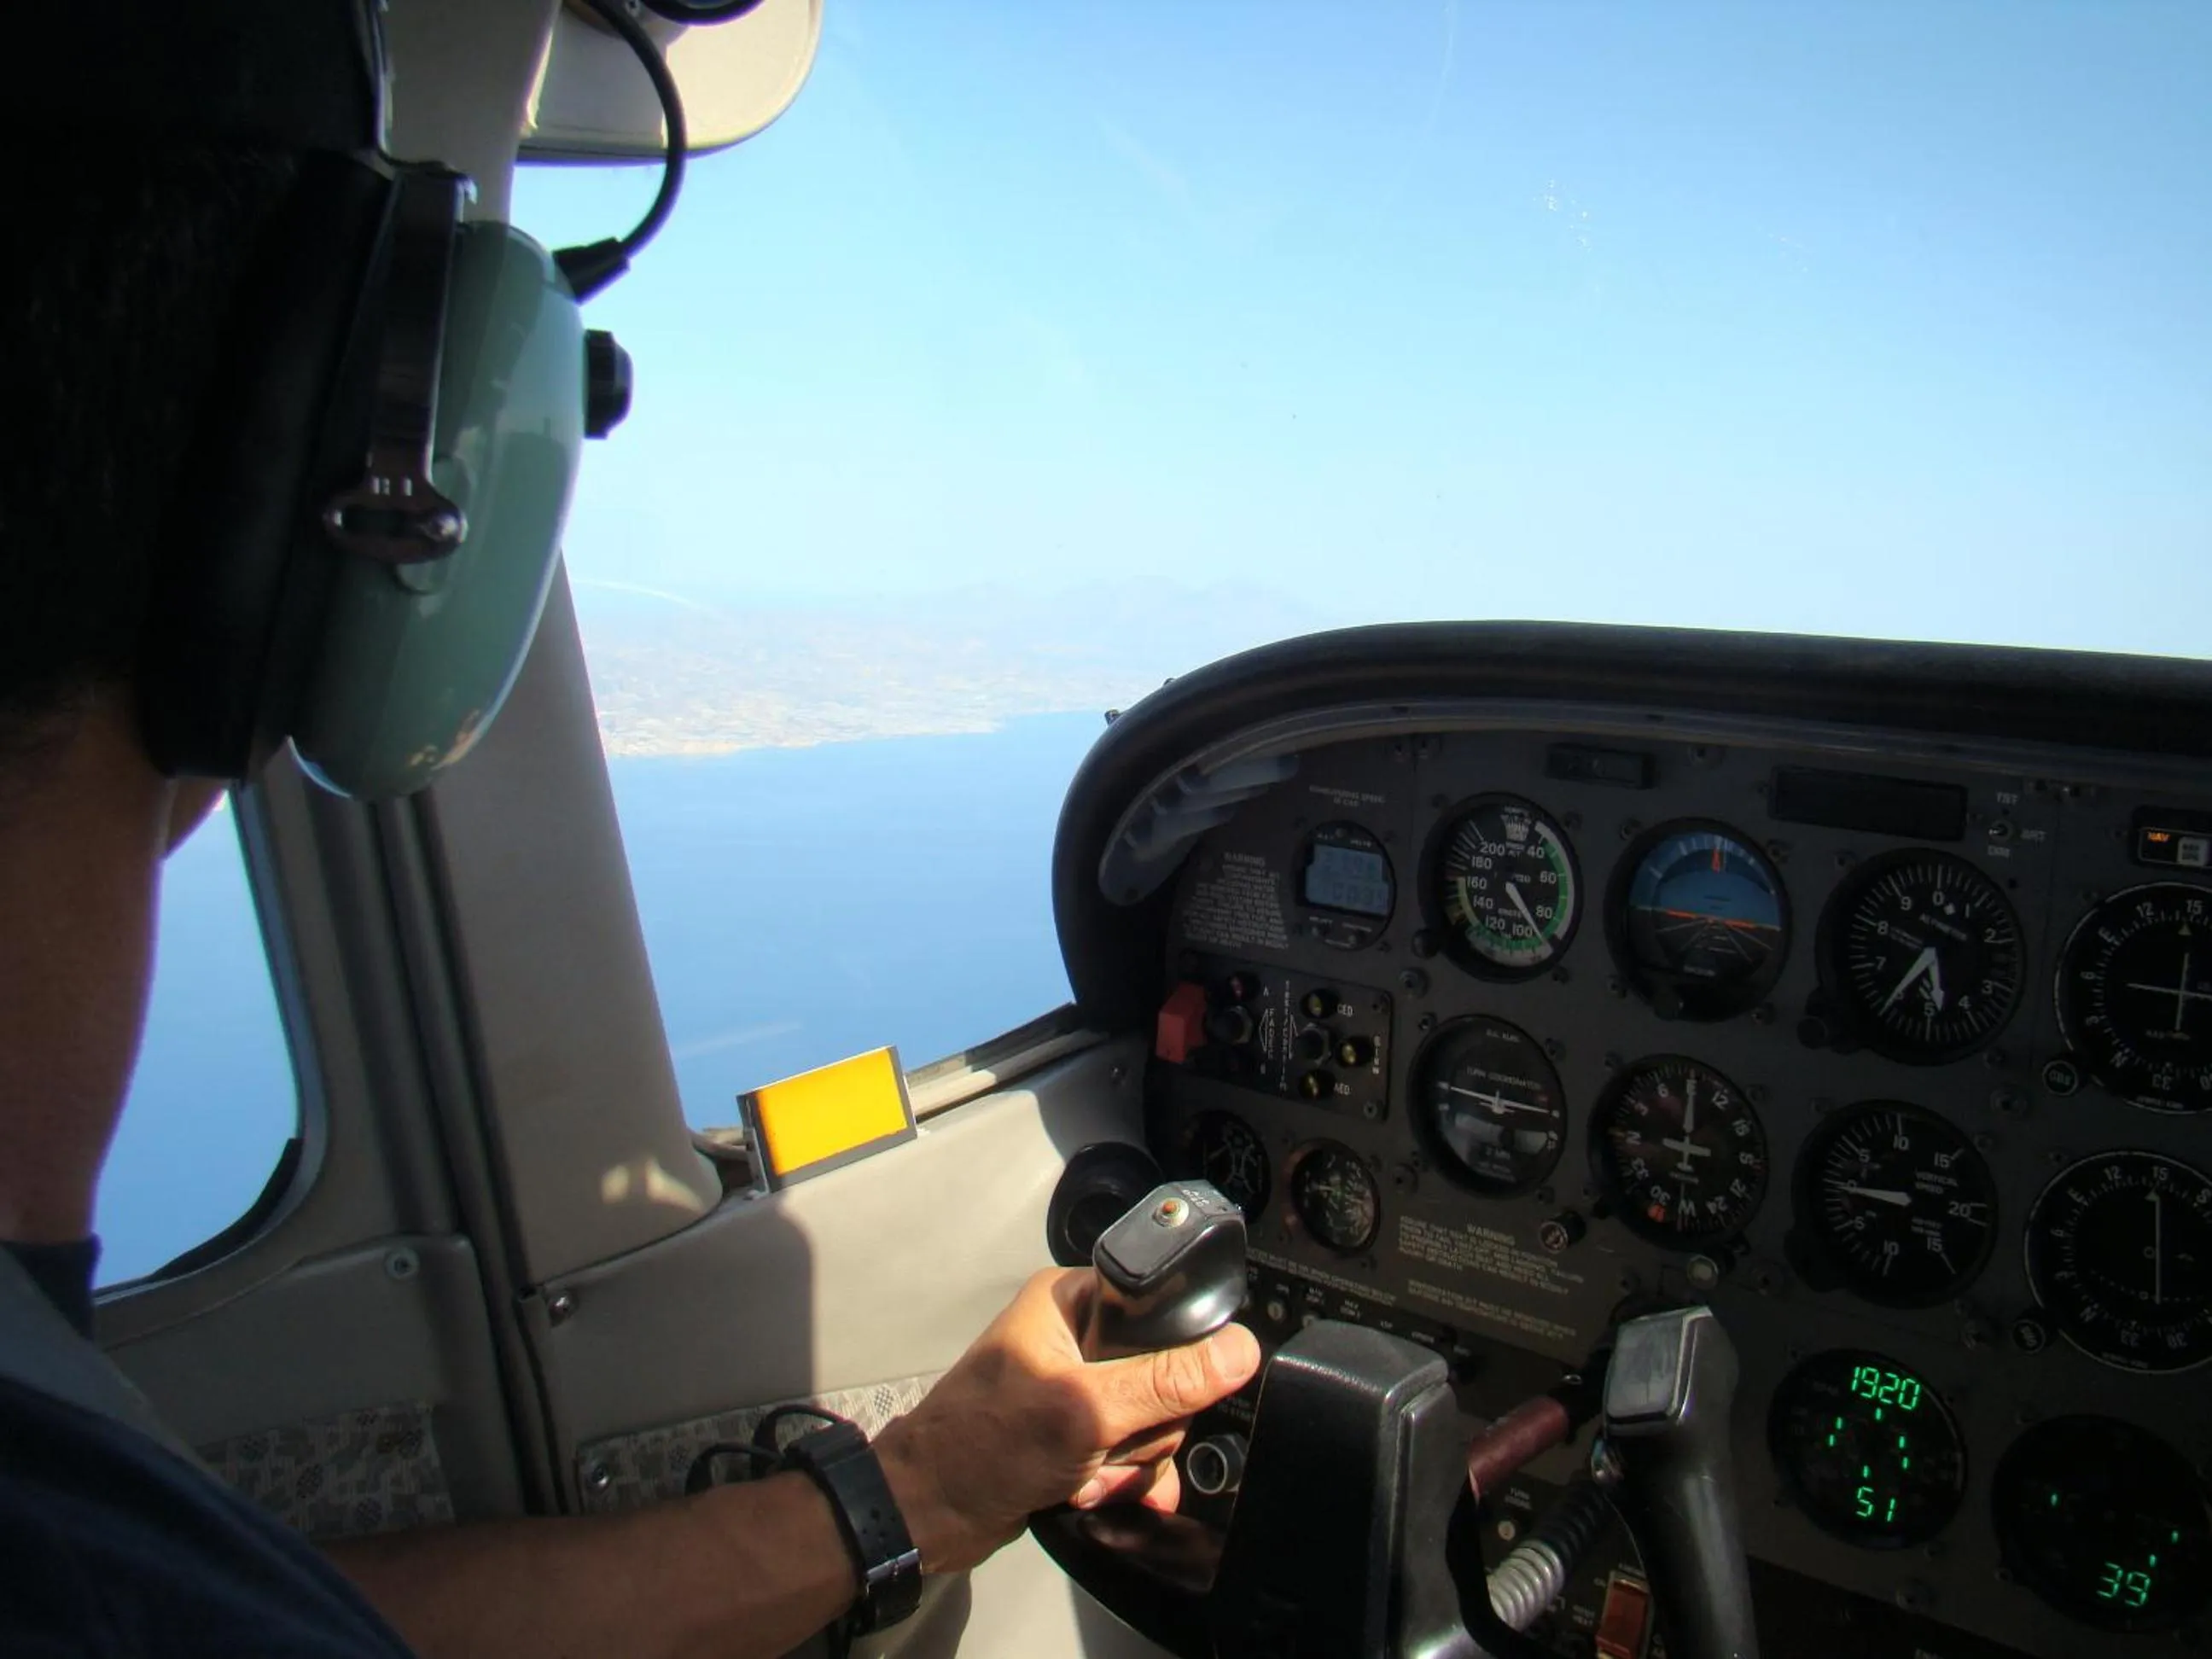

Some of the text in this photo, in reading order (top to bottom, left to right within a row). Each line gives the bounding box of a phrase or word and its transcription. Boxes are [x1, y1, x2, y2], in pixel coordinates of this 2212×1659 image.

[1480, 841, 1505, 856] 200
[1528, 845, 1545, 859] 40
[1472, 856, 1492, 870] 180
[1467, 876, 1487, 889] 160
[1540, 870, 1557, 884] 60
[1473, 895, 1493, 909] 140
[1900, 896, 1912, 911] 9
[1932, 890, 1944, 905] 0
[1535, 905, 1553, 919] 80
[1965, 903, 1970, 919] 1
[2135, 901, 2155, 919] 12
[2186, 899, 2205, 915] 15
[1486, 915, 1505, 930] 120
[1877, 920, 1889, 935] 8
[1512, 924, 1533, 938] 100
[1983, 928, 1997, 943] 2
[1875, 956, 1887, 970] 7
[1263, 986, 1269, 997] A
[1981, 980, 1994, 995] 3
[1336, 1004, 1353, 1017] CED
[1924, 1003, 1936, 1017] 5
[1958, 996, 1971, 1010] 4
[1334, 1082, 1351, 1096] AED
[1656, 1083, 1669, 1098] 6
[1685, 1079, 1697, 1097] E
[1711, 1090, 1730, 1111] 12
[1633, 1101, 1649, 1116] 3
[1626, 1130, 1642, 1145] N
[1893, 1134, 1910, 1151] 10
[1739, 1151, 1755, 1165] S
[1859, 1148, 1871, 1163] 5
[1934, 1151, 1952, 1168] 15
[1631, 1157, 1650, 1180] 33
[2103, 1165, 2123, 1181] 12
[2151, 1165, 2169, 1181] 15
[1650, 1185, 1671, 1206] 30
[1730, 1178, 1747, 1199] 21
[1679, 1198, 1697, 1217] W
[1706, 1196, 1728, 1215] 24
[1947, 1200, 1971, 1218] 20
[1854, 1216, 1866, 1231] 5
[1883, 1239, 1900, 1255] 10
[1927, 1237, 1943, 1253] 15
[1851, 1365, 1921, 1411] 1920
[1855, 1486, 1896, 1522] 51
[2096, 1561, 2151, 1608] 39
